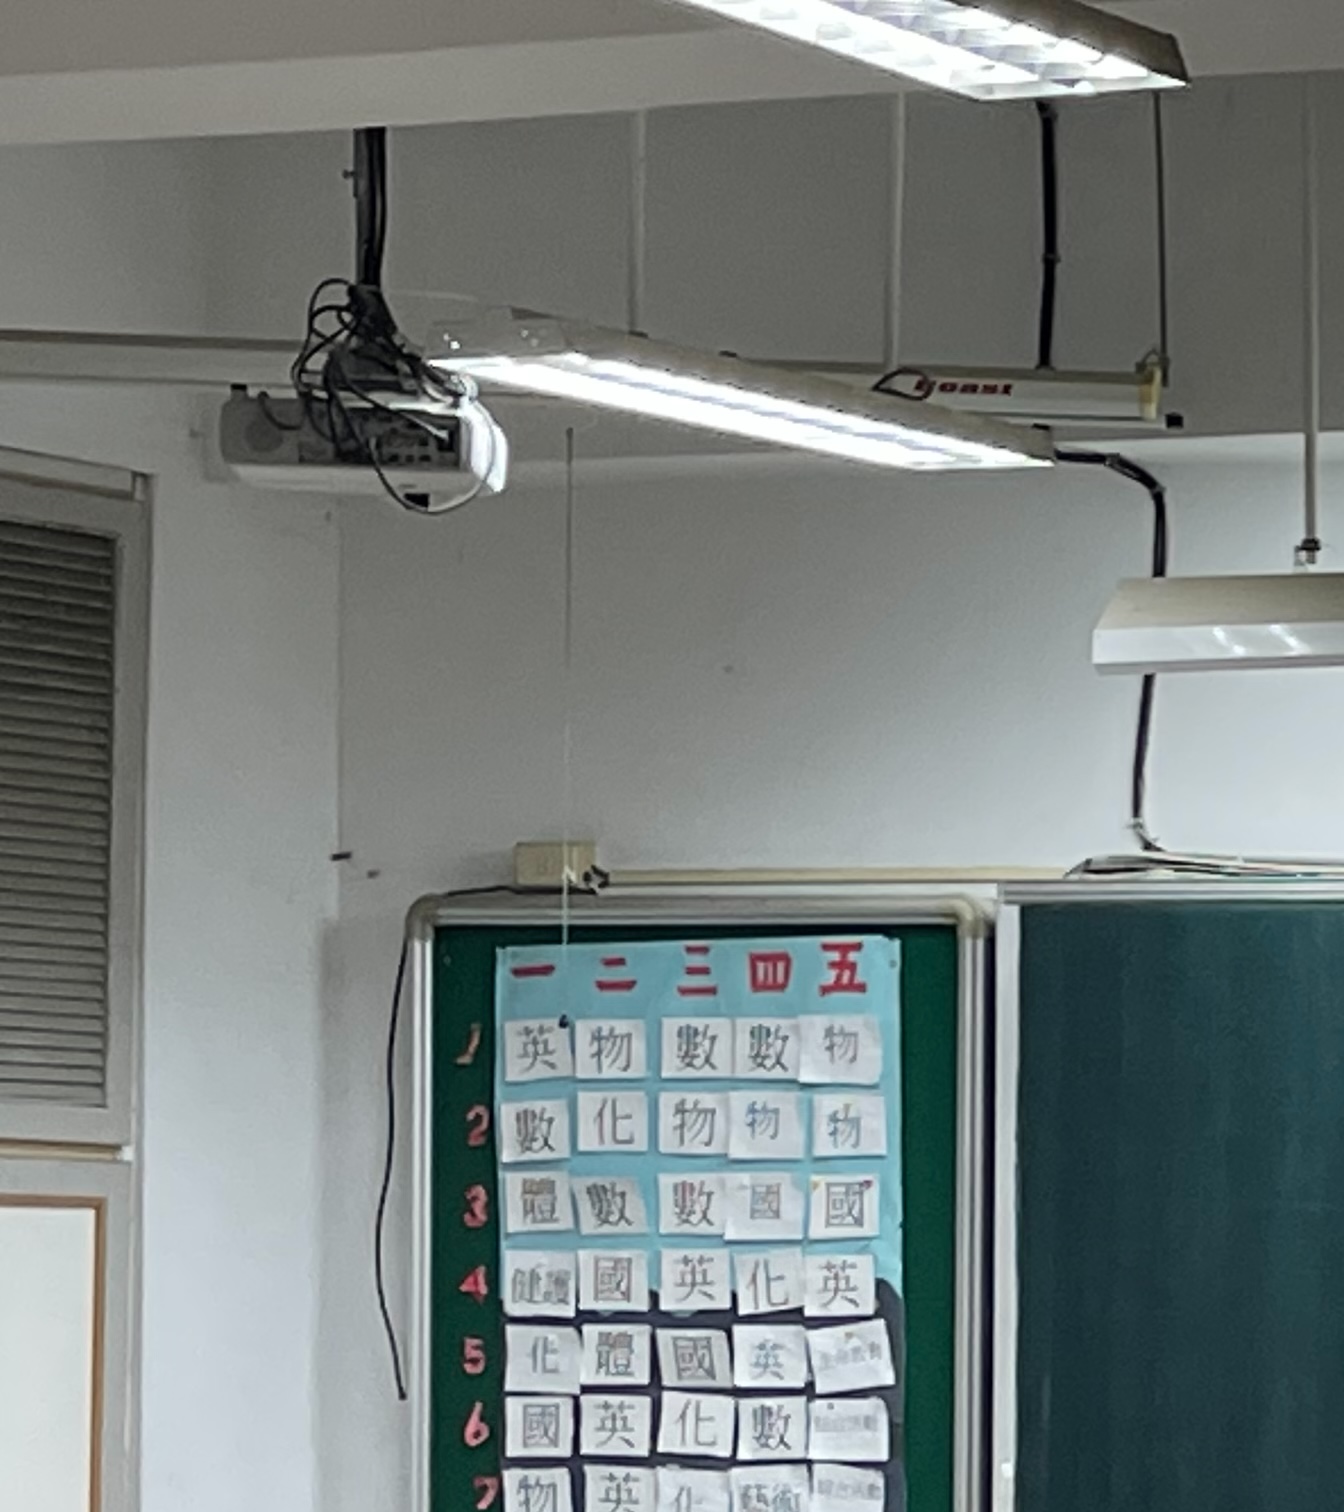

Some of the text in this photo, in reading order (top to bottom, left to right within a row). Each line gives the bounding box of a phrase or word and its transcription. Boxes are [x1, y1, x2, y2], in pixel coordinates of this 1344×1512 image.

[510, 941, 867, 997] 一 二 三 四 五
[517, 1025, 558, 1074] 英
[590, 1025, 633, 1074] 物
[676, 1023, 718, 1072] 數
[749, 1023, 789, 1072] 數
[823, 1024, 859, 1065] 物
[466, 1097, 862, 1154] 2 數 化 物 物 物
[463, 1177, 865, 1229] 3 體 數 數 國 國
[458, 1265, 489, 1303] 4
[593, 1255, 633, 1303] 國
[673, 1254, 716, 1302] 英
[747, 1258, 789, 1311] 化
[818, 1260, 860, 1309] 英
[462, 1336, 486, 1375] 5
[527, 1336, 560, 1375] 化
[595, 1331, 635, 1377] 體
[671, 1335, 717, 1382] 國
[750, 1339, 785, 1381] 英
[464, 1401, 490, 1447] 6
[523, 1403, 560, 1449] 國
[594, 1400, 636, 1449] 英
[675, 1399, 717, 1448] 化
[752, 1404, 792, 1450] 數
[473, 1476, 499, 1511] 7
